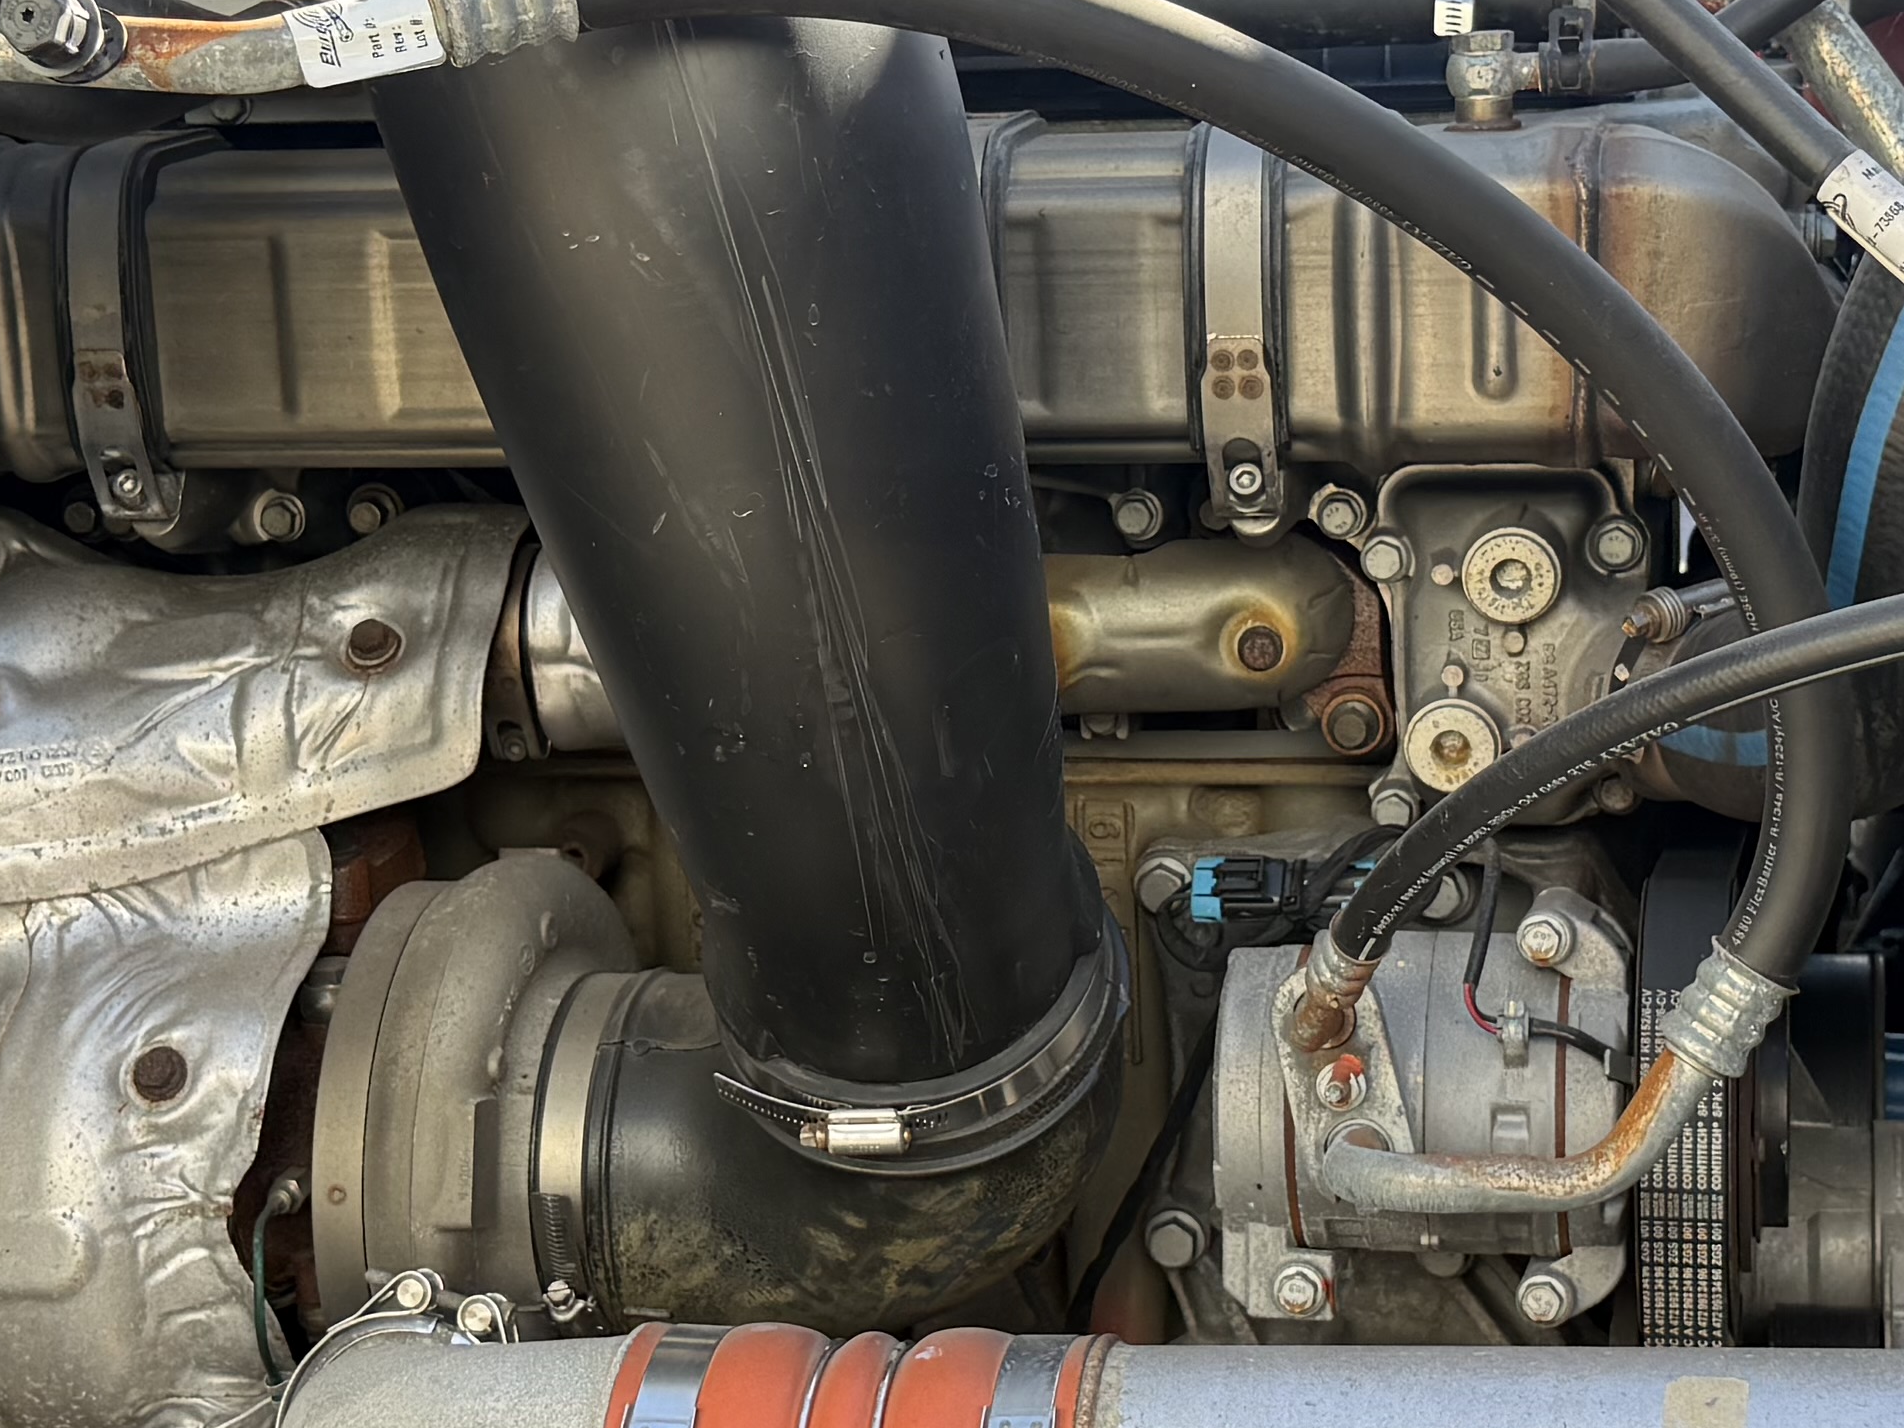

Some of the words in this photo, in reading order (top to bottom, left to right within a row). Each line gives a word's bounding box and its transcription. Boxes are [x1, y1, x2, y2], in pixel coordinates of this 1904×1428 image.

[368, 33, 384, 59] Part
[414, 29, 429, 49] Lot
[1600, 721, 1680, 762] GALAXY
[1712, 1092, 1722, 1118] 8PK
[1698, 1222, 1708, 1240] 001
[1712, 1223, 1722, 1241] 001
[1698, 1244, 1708, 1265] ZGS
[1712, 1244, 1722, 1266] ZGS
[1698, 1328, 1708, 1337] A
